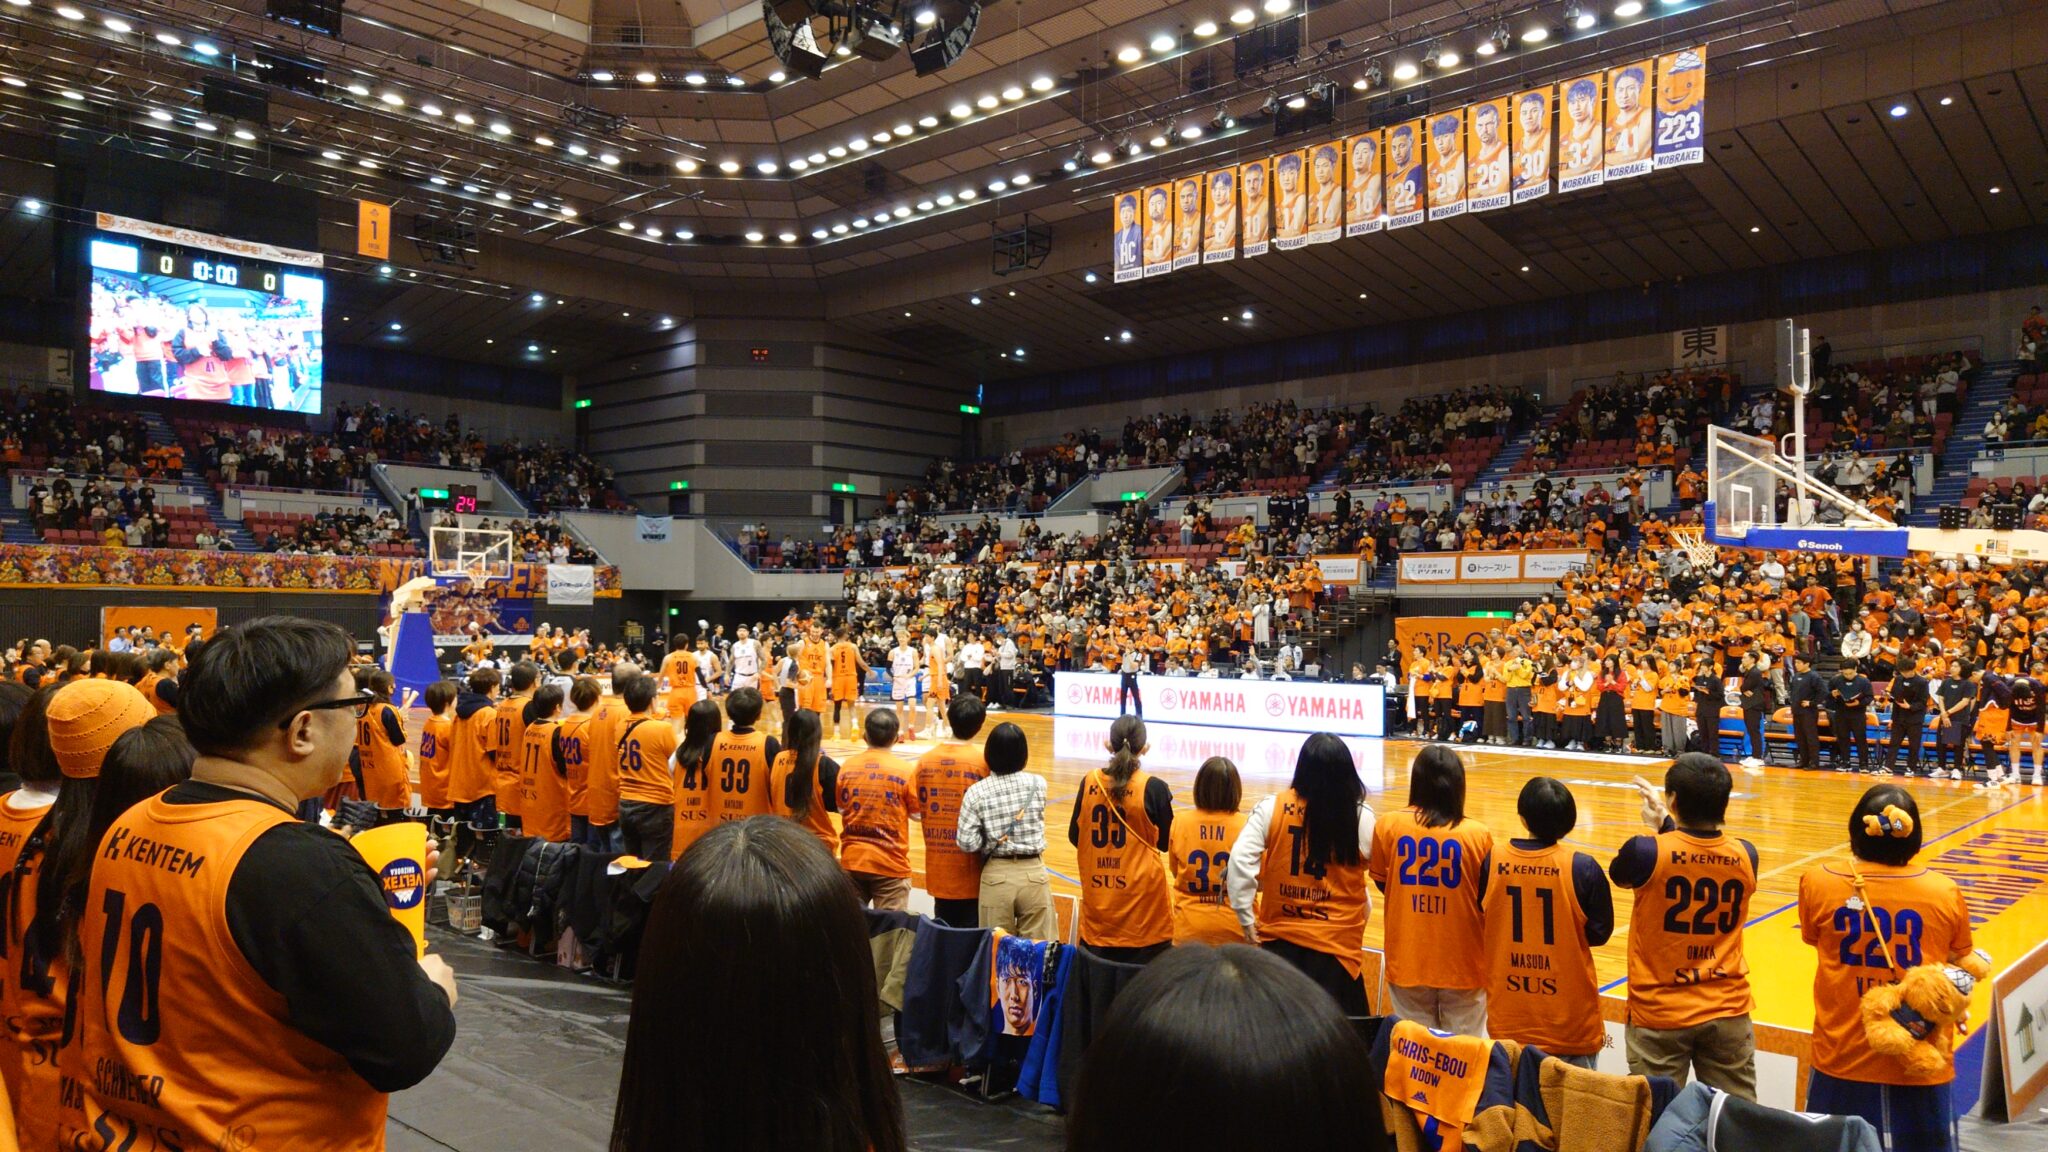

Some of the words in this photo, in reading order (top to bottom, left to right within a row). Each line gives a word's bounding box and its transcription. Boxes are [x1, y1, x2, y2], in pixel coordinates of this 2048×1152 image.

[1615, 123, 1640, 153] 41
[1658, 111, 1700, 146] 223
[1568, 138, 1593, 170] 33
[1656, 150, 1700, 167] NOBRAKE!
[1477, 160, 1500, 191] 26
[1521, 152, 1544, 182] 30
[1606, 162, 1648, 179] NOBRAKE!
[1515, 184, 1547, 201] NOBRAKE!
[1561, 173, 1600, 191] NOBRAKE!
[1395, 180, 1415, 208] 22
[1471, 196, 1507, 211] NOBRAKE!
[1389, 213, 1422, 227] NOBRAKE!
[1431, 203, 1464, 219] NOBRAKE!
[371, 220, 377, 240] 1
[1182, 227, 1192, 250] 5
[1214, 221, 1226, 243] 6
[1348, 221, 1380, 235] NOBRAKE!
[1120, 241, 1136, 265] HC
[1153, 234, 1163, 258] 0
[1206, 250, 1233, 261] NOBRAKE!
[160, 255, 173, 274] 0
[1146, 263, 1170, 274] NOBRAKE!
[1175, 255, 1197, 267] NOBRAKE!
[193, 261, 237, 285] 10:00
[264, 273, 276, 291] 0
[1117, 269, 1140, 280] NOBRAKE!
[1682, 326, 1718, 359] 東
[456, 496, 476, 512] 24
[1808, 541, 1843, 551] Senoh
[676, 661, 688, 674] 30
[1179, 690, 1246, 713] YAMAHA
[1287, 695, 1364, 720] YAMAHA
[498, 718, 511, 746] 16
[525, 743, 540, 774] 11
[619, 739, 643, 771] 26
[721, 758, 750, 794] 33
[681, 810, 707, 820] SUS
[1092, 804, 1127, 849] 33
[1200, 825, 1225, 841] RIN
[126, 838, 206, 878] KENTEM
[1397, 835, 1462, 889] 223
[1690, 853, 1742, 866] KENTEM
[1513, 864, 1560, 877] KENTEM
[382, 873, 423, 891] VELTEX
[1091, 875, 1127, 889] SUS
[1282, 903, 1329, 920] SUS
[1412, 894, 1447, 915] VELTI
[1506, 885, 1555, 945] 11
[1663, 875, 1745, 935] 223
[1833, 906, 1923, 970] 223
[102, 888, 164, 1046] 10
[1511, 952, 1551, 971] MASUDA
[1506, 975, 1557, 996] SUS
[1397, 1037, 1468, 1079] CHRIS-EBOU
[1409, 1065, 1441, 1089] NDOW
